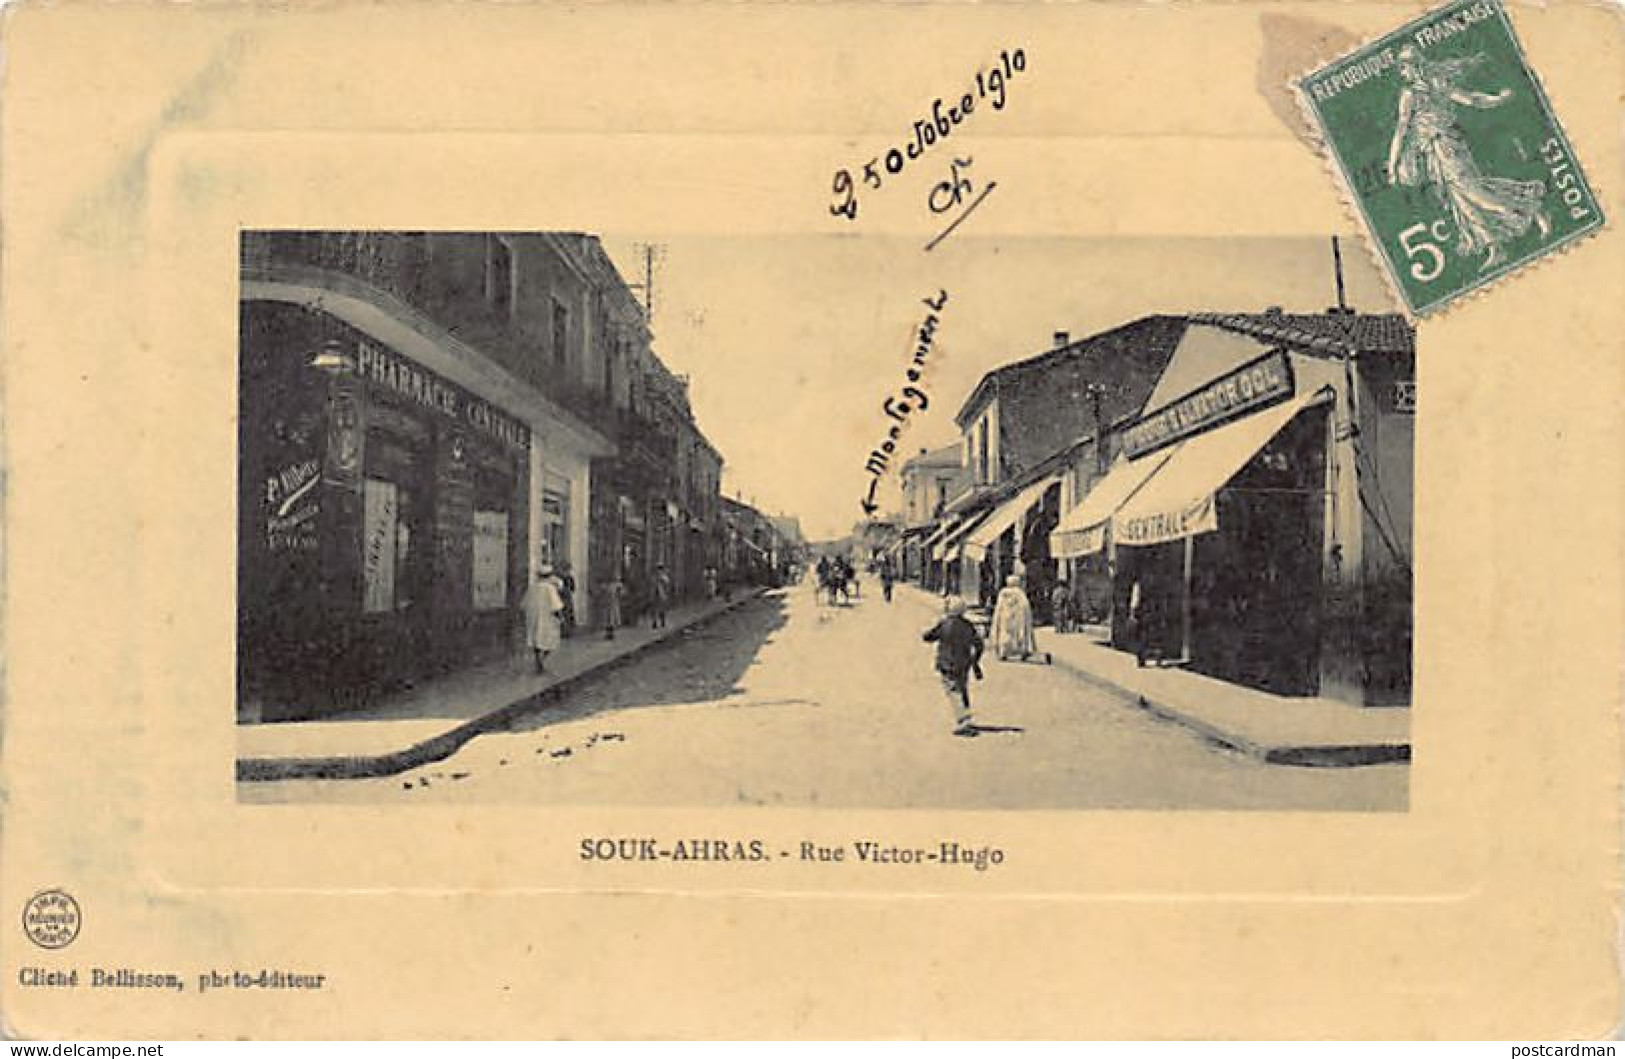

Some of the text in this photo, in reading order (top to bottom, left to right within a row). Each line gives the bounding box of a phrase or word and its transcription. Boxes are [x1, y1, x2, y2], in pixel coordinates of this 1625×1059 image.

[1541, 137, 1590, 220] POSTES
[358, 342, 461, 418] PHARMACIE
[800, 841, 846, 863] Rue
[855, 841, 1005, 871] Victor-Hugo
[19, 966, 79, 988] Cliché
